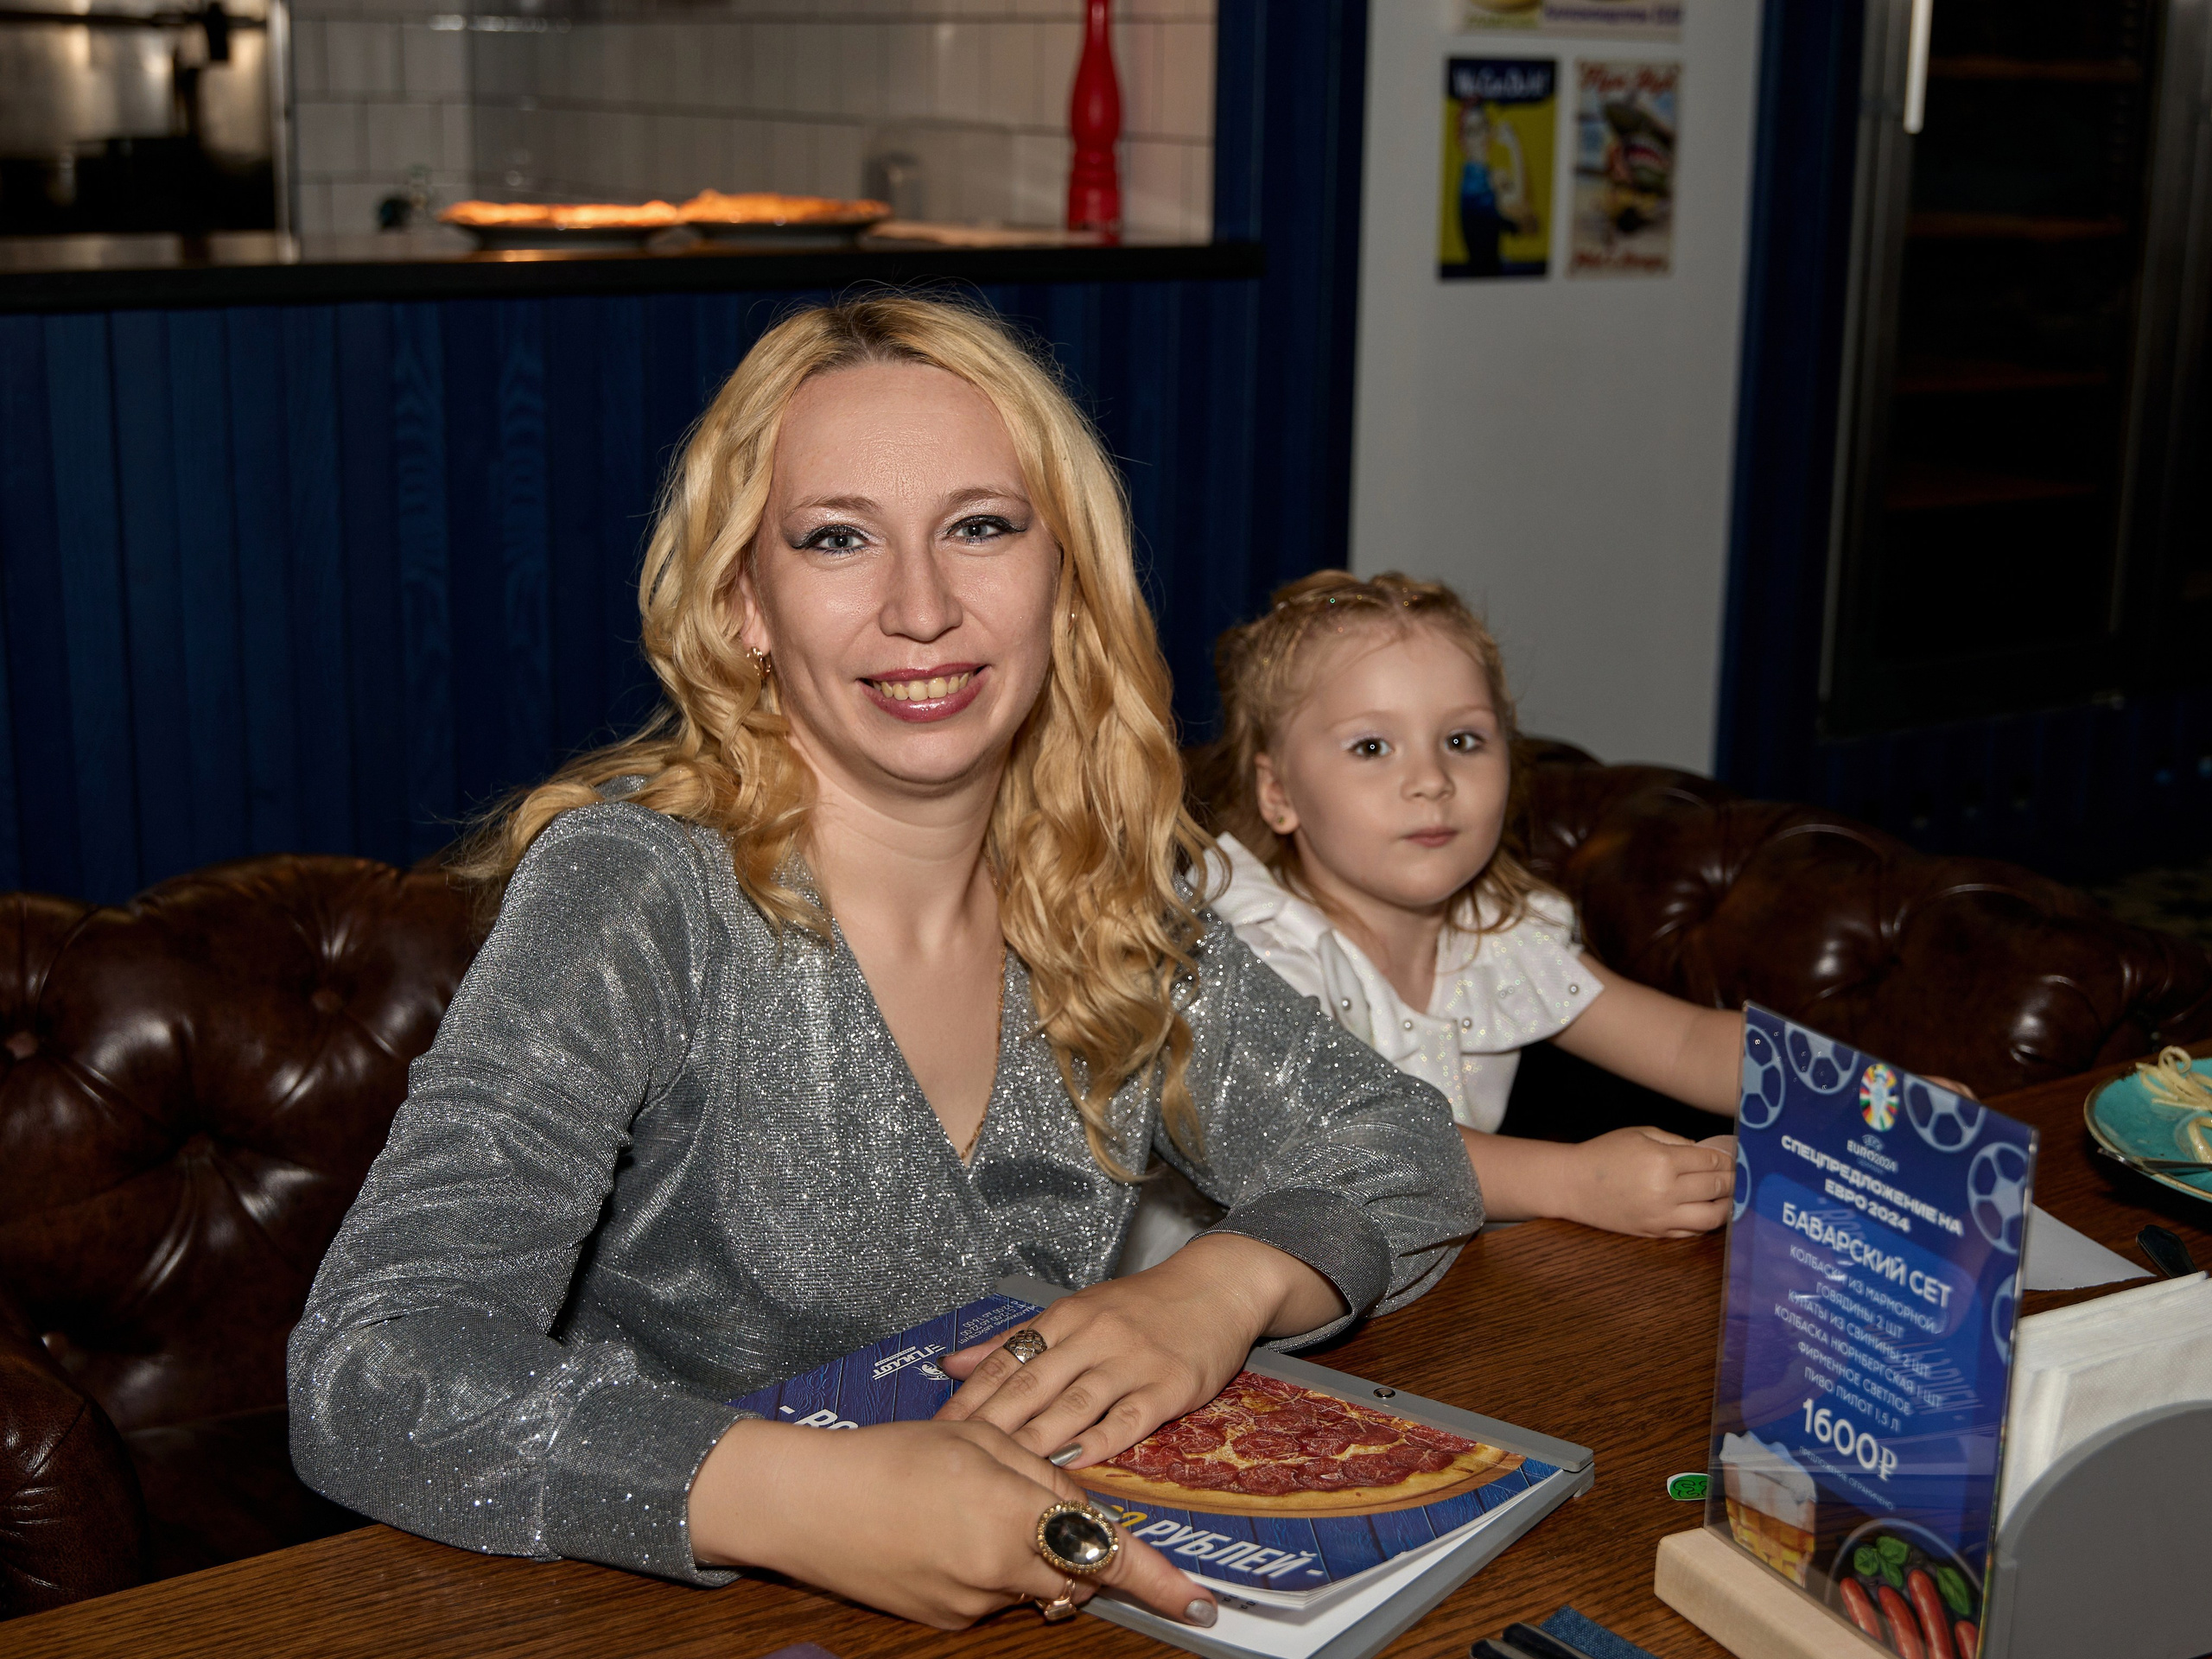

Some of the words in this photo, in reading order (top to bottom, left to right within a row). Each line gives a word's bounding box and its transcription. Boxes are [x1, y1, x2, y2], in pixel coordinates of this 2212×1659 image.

[1781, 1135, 1937, 1225] СПЕЦПРЕДЛОЖЕНИЕ
[1938, 1211, 1964, 1236] НА
[1825, 1178, 1867, 1211] ЕВРО
[1867, 1201, 1911, 1233] 2024
[1782, 1201, 1907, 1287] БАВАРСКИЙ
[1909, 1270, 1952, 1308] СЕТ
[1788, 1288, 1828, 1320] КУПАТЫ
[1828, 1313, 1846, 1331] ИЗ
[1847, 1322, 1899, 1361] СВИНИНЫ
[1902, 1353, 1910, 1366] 2
[1910, 1357, 1931, 1378] ШТ
[1815, 1281, 1873, 1323] ГОВЯДИНЫ
[1876, 1314, 1885, 1329] 2
[1885, 1319, 1905, 1338] ШТ
[1848, 1277, 1864, 1295] ИЗ
[1865, 1285, 1936, 1333] МАРМОРНОЙ
[1774, 1305, 1828, 1344] КОЛБАСКА
[1830, 1338, 1914, 1393] НЮРНБЕРГСКАЯ
[1923, 1389, 1942, 1408] ШТ
[1798, 1341, 1861, 1388] ФИРМЕННОЕ
[1862, 1377, 1911, 1416] СВЕТЛОЕ
[1804, 1366, 1835, 1393] ПИВО
[1835, 1385, 1873, 1415] ПИЛОТ
[1874, 1408, 1889, 1427] 1,5
[1891, 1417, 1902, 1433] Л
[1799, 1446, 1848, 1483] ПРЕДЛОЖЕНИЕ
[1848, 1478, 1894, 1510] ОГРАНИЧЕНО
[1132, 1518, 1319, 1579] РУБЛЕЙ
